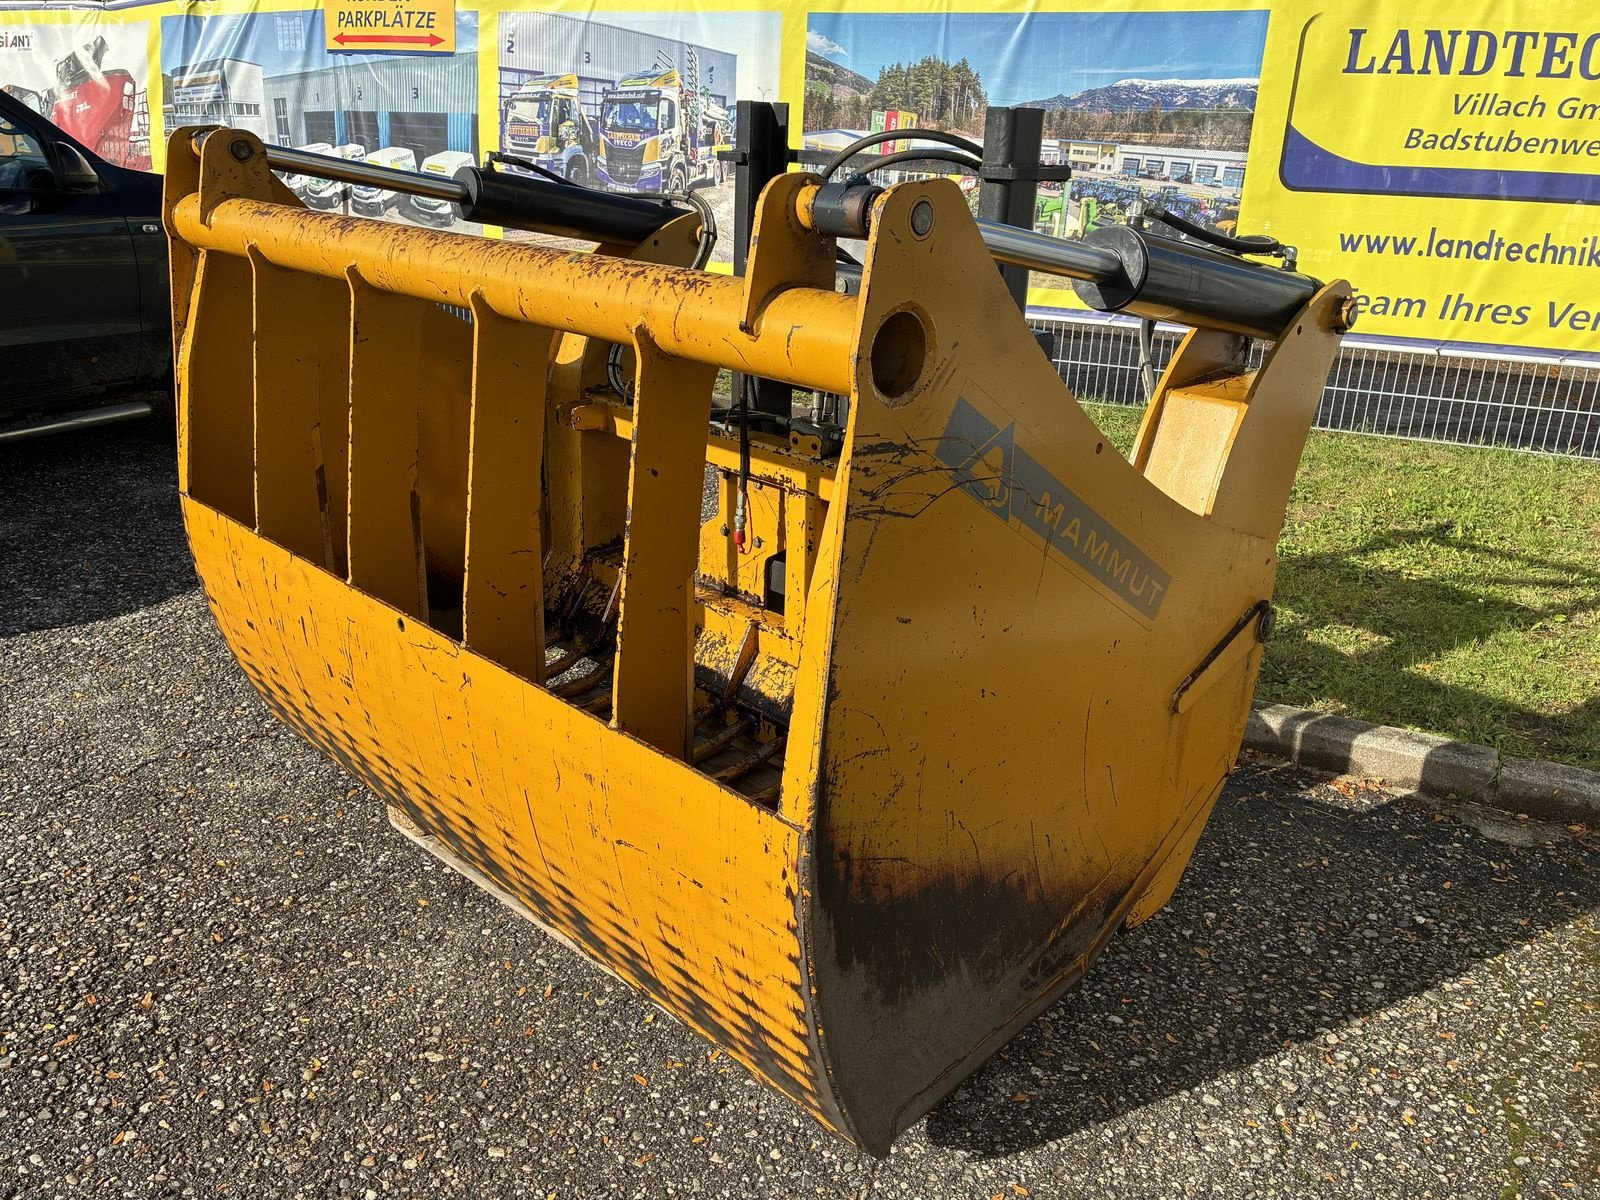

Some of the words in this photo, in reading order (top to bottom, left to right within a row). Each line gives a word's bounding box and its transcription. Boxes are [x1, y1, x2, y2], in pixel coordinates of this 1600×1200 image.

[338, 5, 436, 28] PARKPLÄTZE
[506, 40, 515, 53] 2
[584, 52, 591, 64] 3
[357, 90, 363, 100] 2
[412, 87, 419, 99] 3
[1452, 93, 1546, 118] Villach
[613, 139, 633, 147] IVECO
[1404, 128, 1600, 157] Badstubenwe
[1339, 227, 1600, 267] www.landtechnik
[1438, 293, 1532, 326] Ihres
[1034, 490, 1164, 607] MAMMUT
